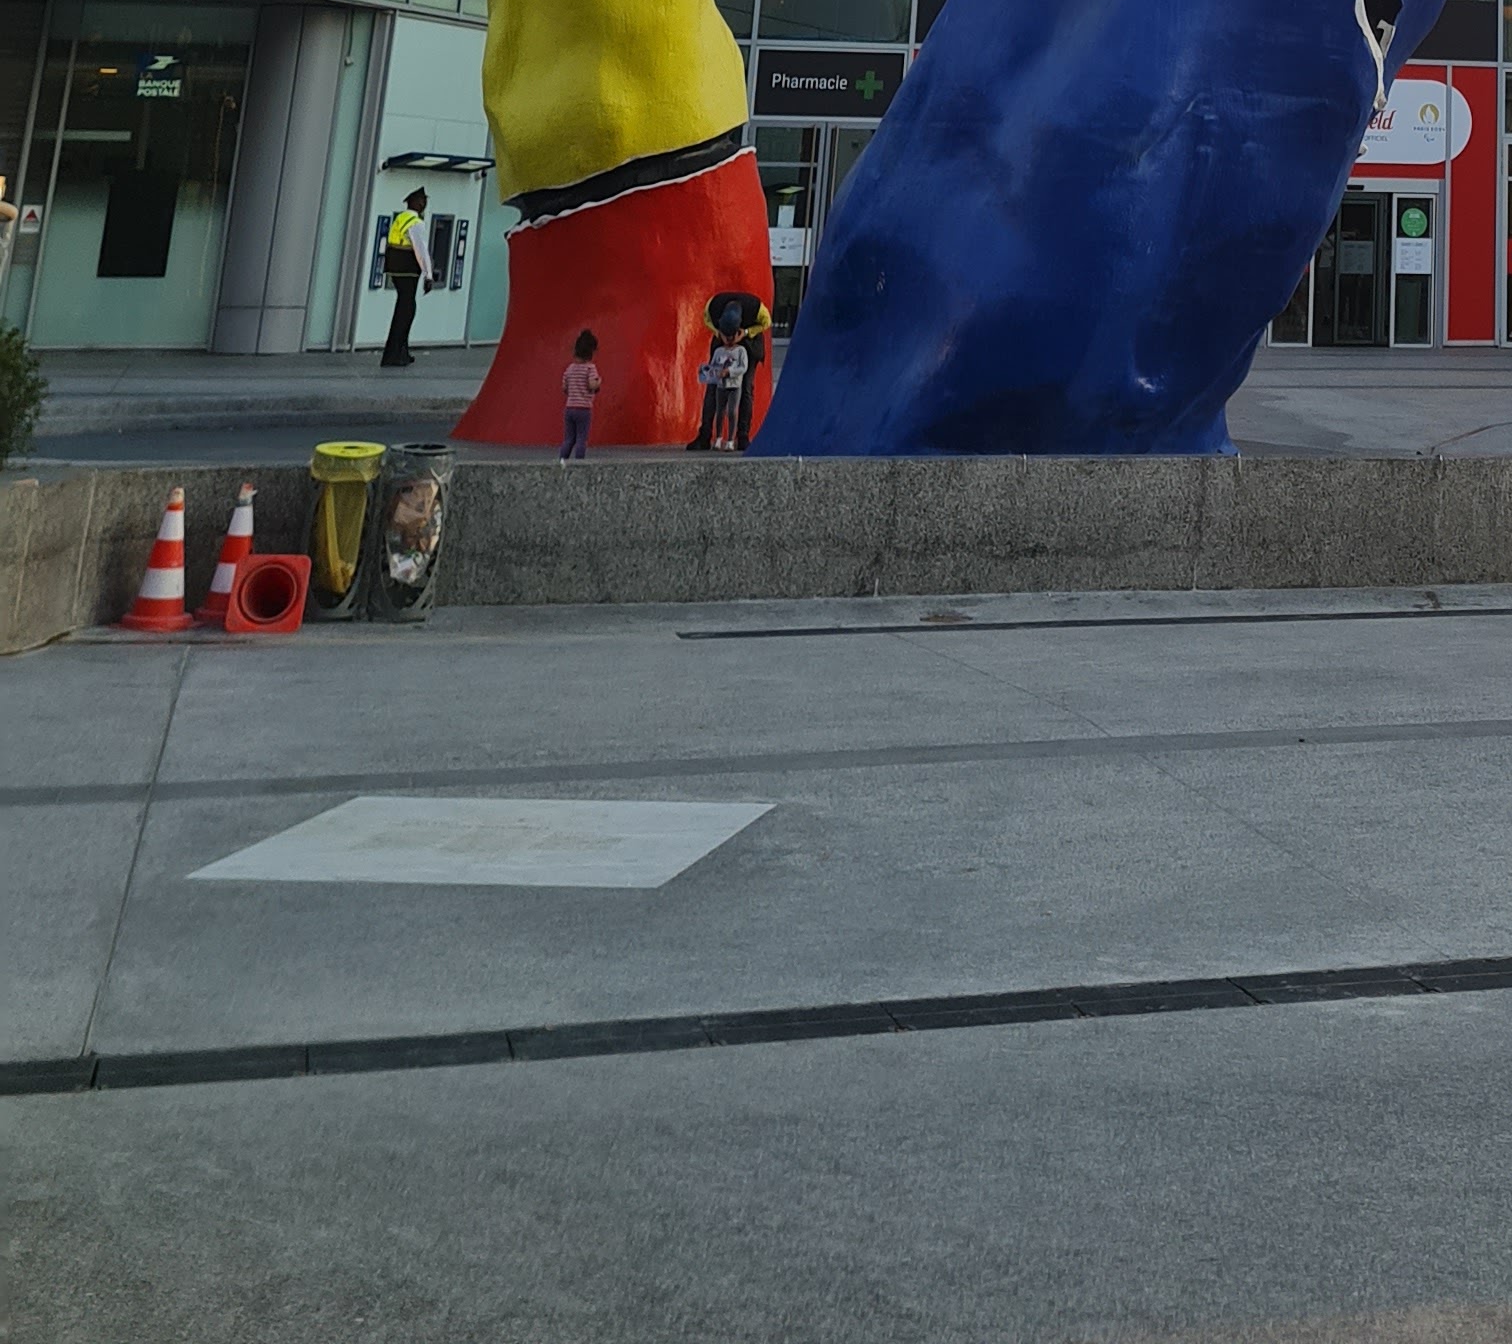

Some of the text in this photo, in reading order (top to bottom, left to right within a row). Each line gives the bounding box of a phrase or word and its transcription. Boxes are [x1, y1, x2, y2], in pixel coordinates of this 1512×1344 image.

[138, 79, 182, 88] BANQUE
[771, 73, 848, 90] Pharmacie
[136, 88, 180, 97] POSTALE
